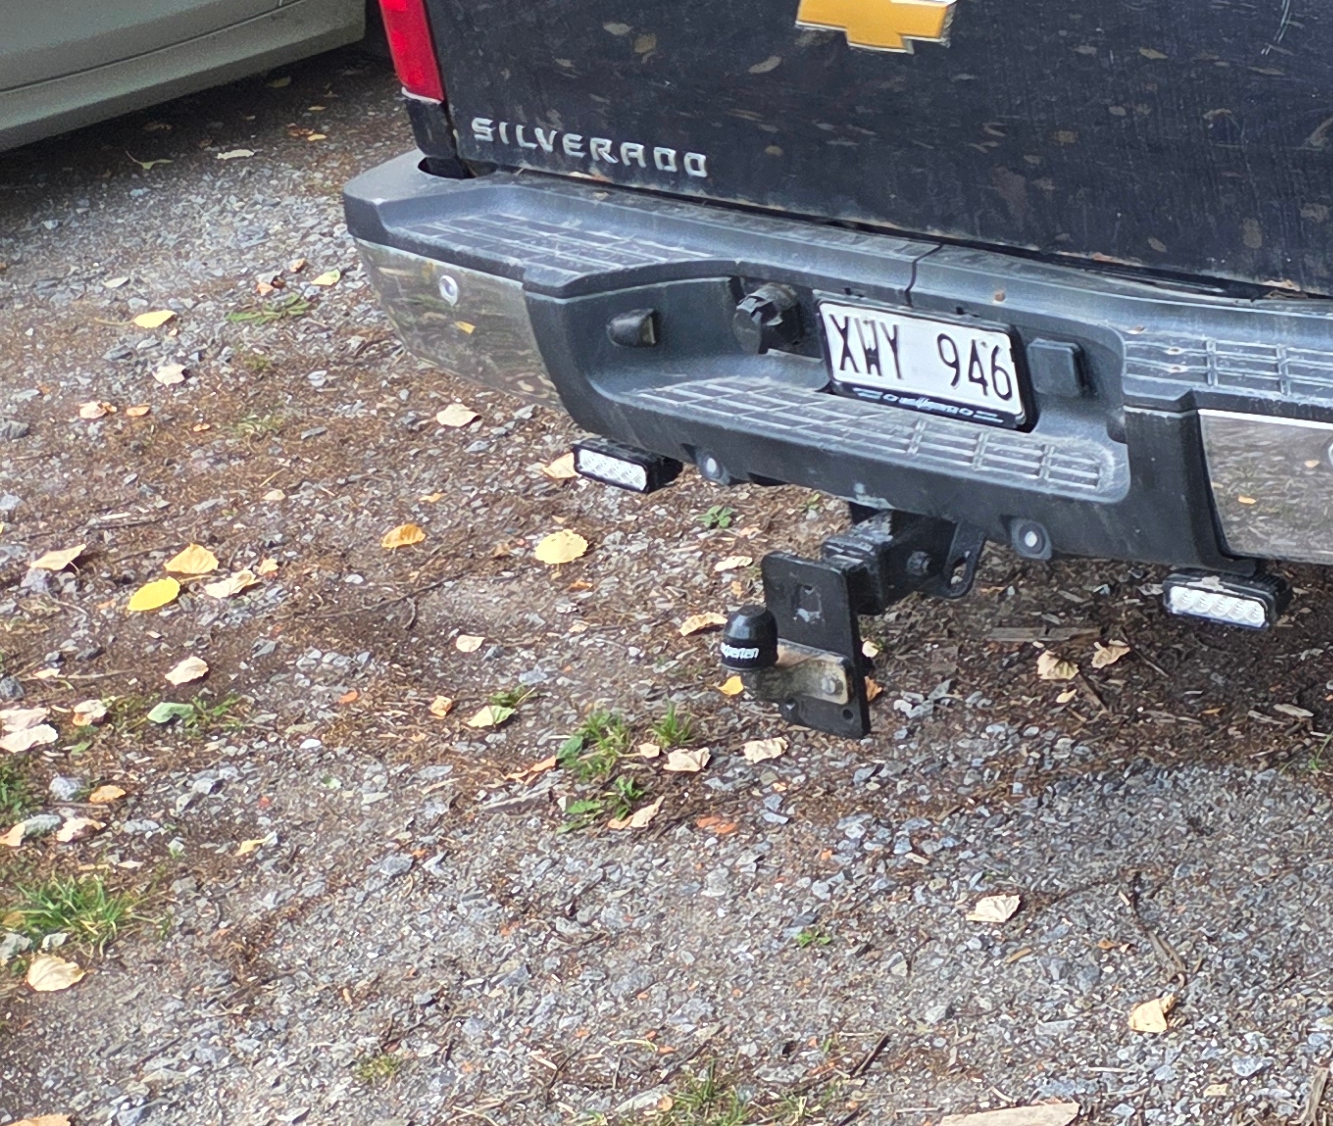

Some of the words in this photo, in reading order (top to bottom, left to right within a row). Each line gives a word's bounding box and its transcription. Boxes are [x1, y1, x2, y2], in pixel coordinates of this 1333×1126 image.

[470, 116, 708, 178] SILVERADO
[829, 314, 904, 380] XWY
[936, 332, 1013, 401] 946
